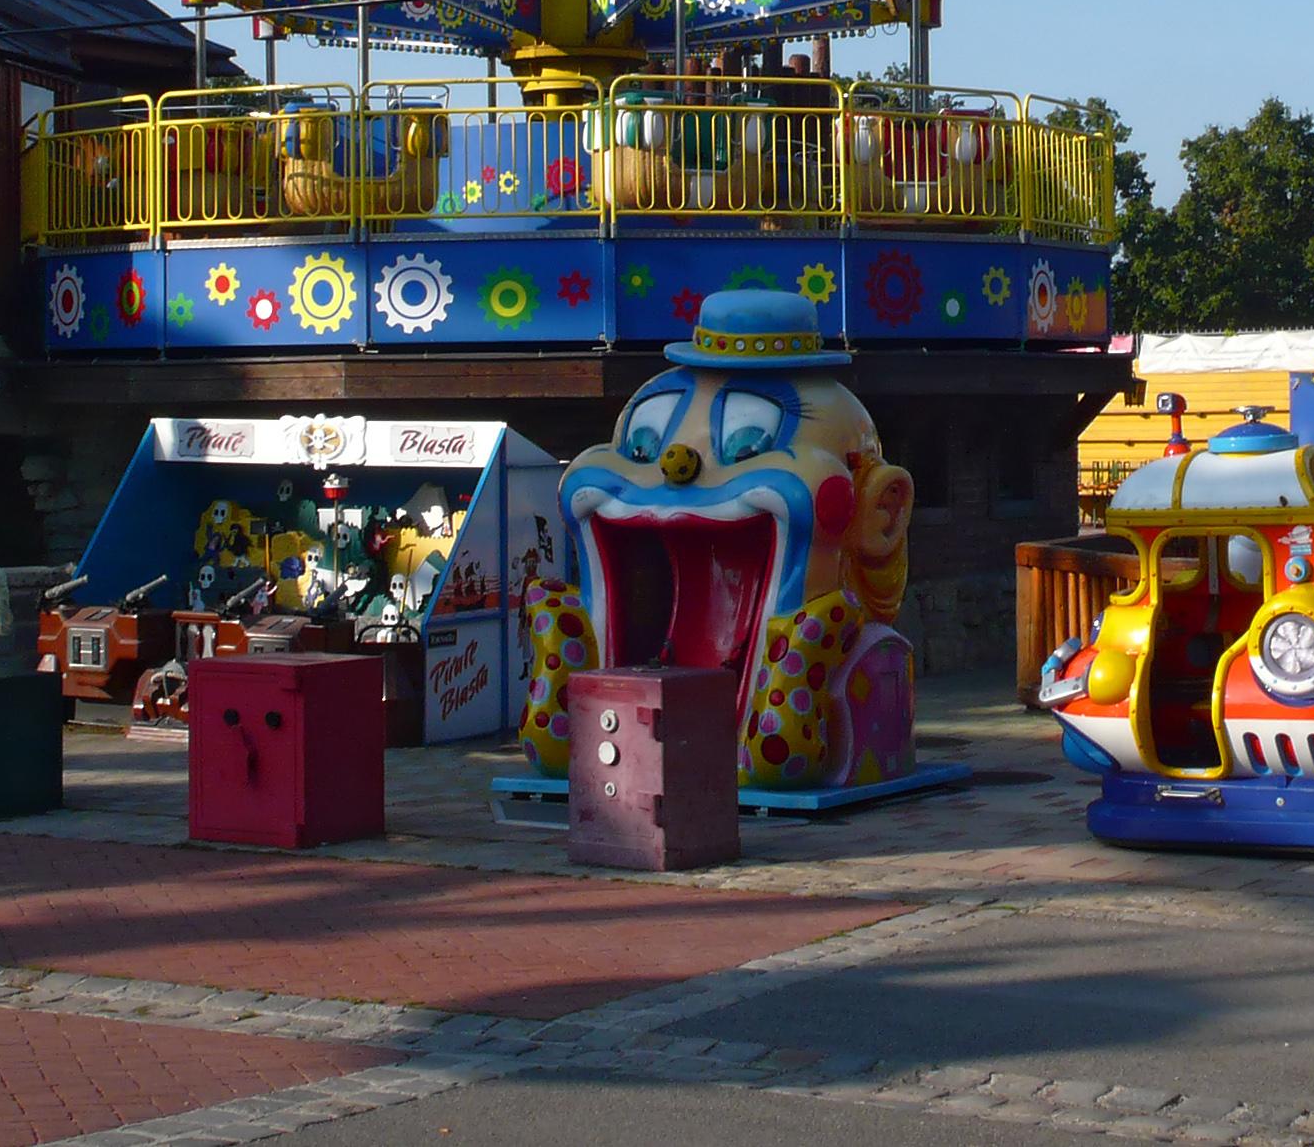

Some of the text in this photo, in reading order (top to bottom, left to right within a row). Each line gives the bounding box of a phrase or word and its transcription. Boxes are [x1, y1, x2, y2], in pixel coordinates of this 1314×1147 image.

[186, 426, 246, 453] Pirate
[399, 429, 468, 454] Blasta
[429, 639, 478, 693] Pirate
[440, 664, 489, 721] Blasta
